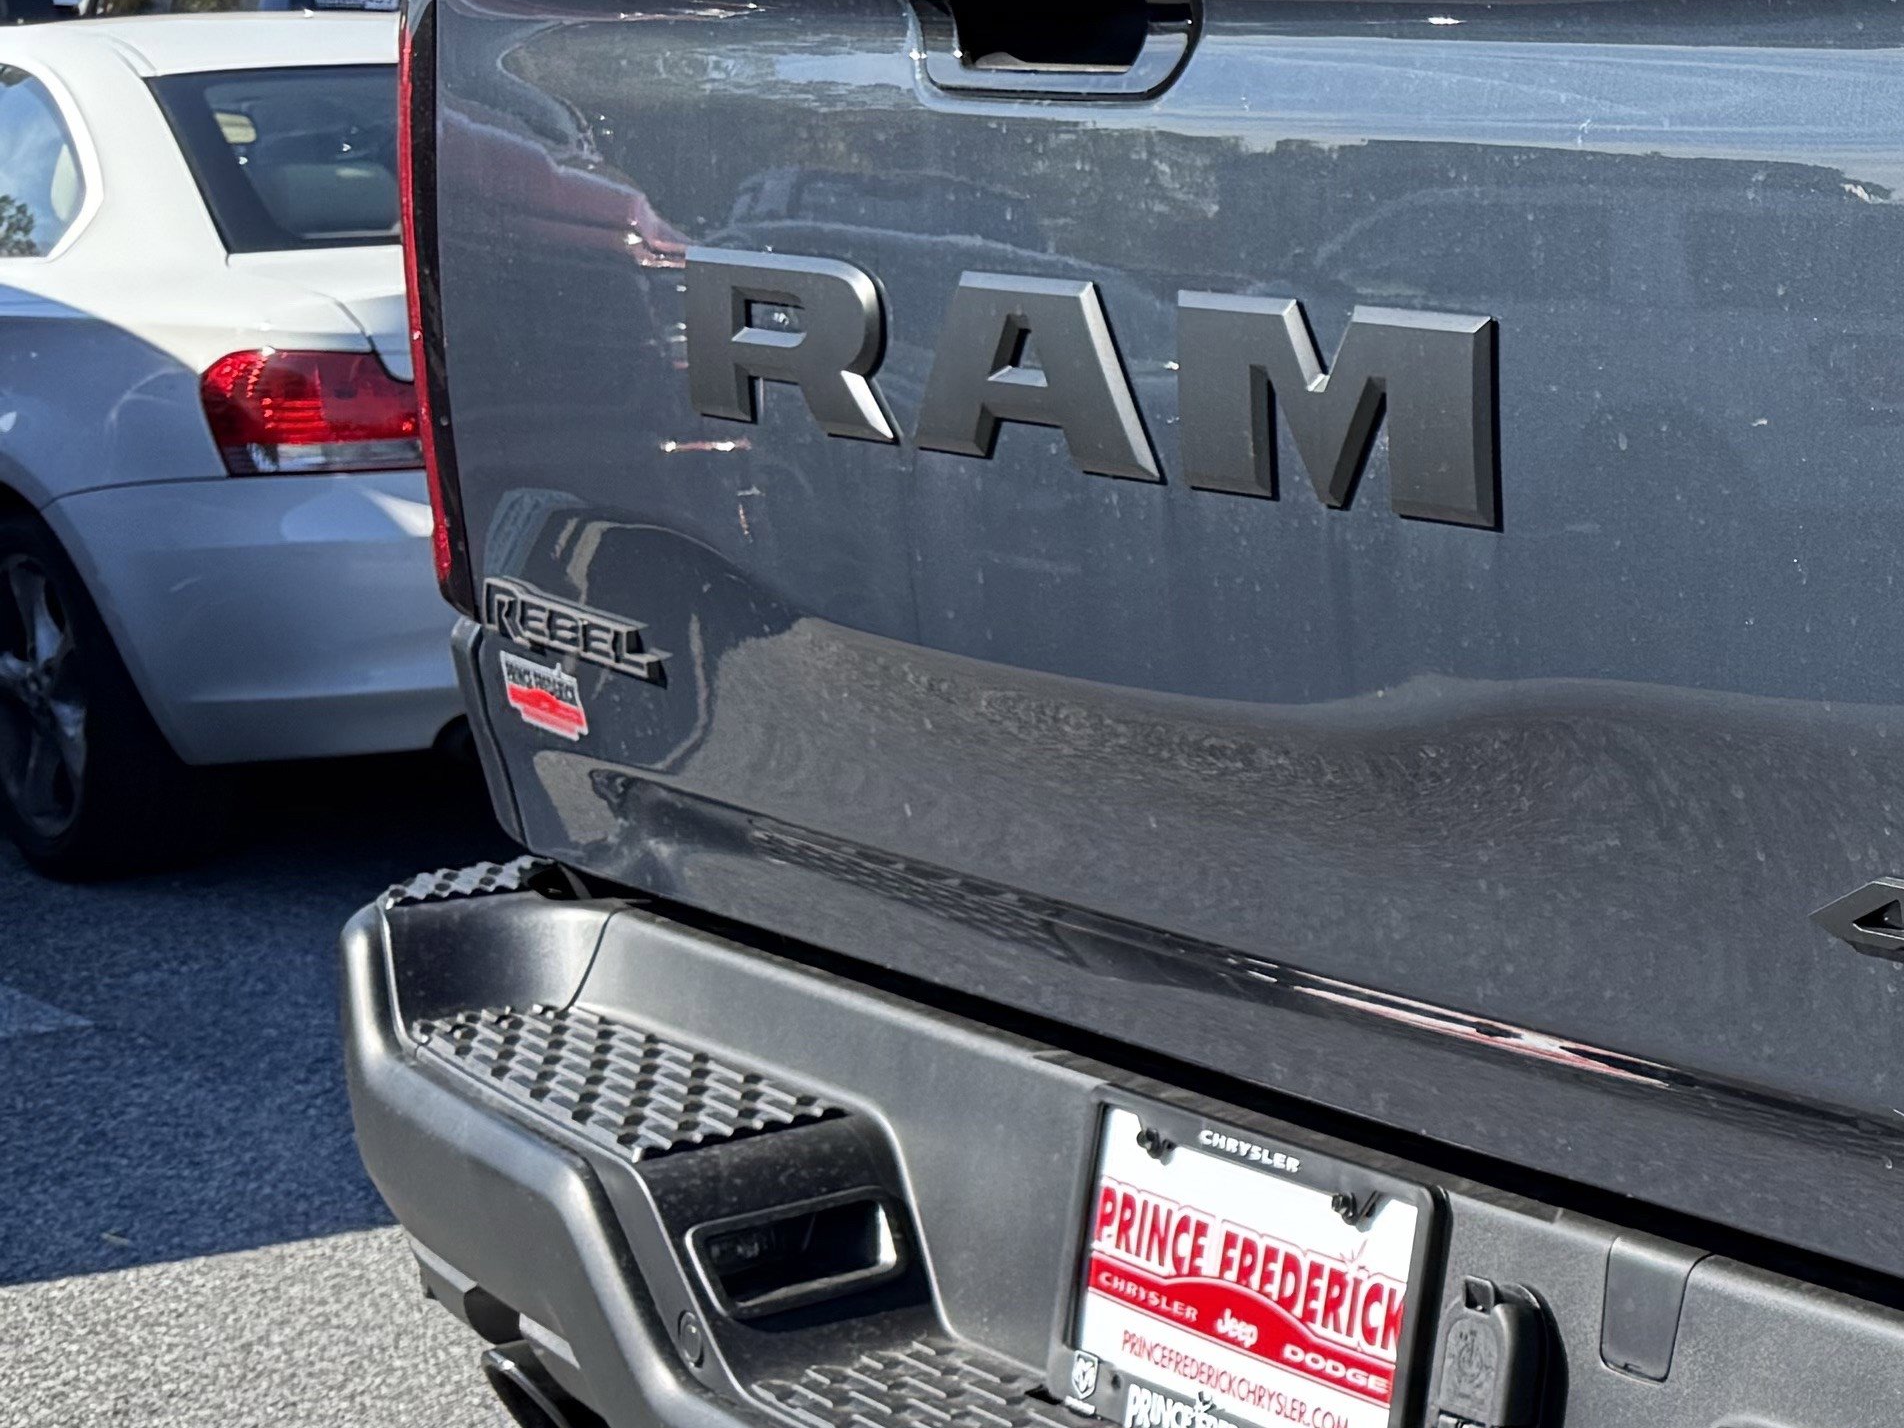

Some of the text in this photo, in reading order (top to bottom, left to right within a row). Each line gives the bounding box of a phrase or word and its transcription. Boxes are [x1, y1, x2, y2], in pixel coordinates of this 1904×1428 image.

[684, 246, 1502, 532] RAM
[483, 575, 673, 689] REBEL
[1198, 1128, 1301, 1174] CHRYSLER
[1098, 1185, 1405, 1353] PRINCE FREDERICK
[1099, 1271, 1391, 1395] CHRYSLER Jeep DODGE
